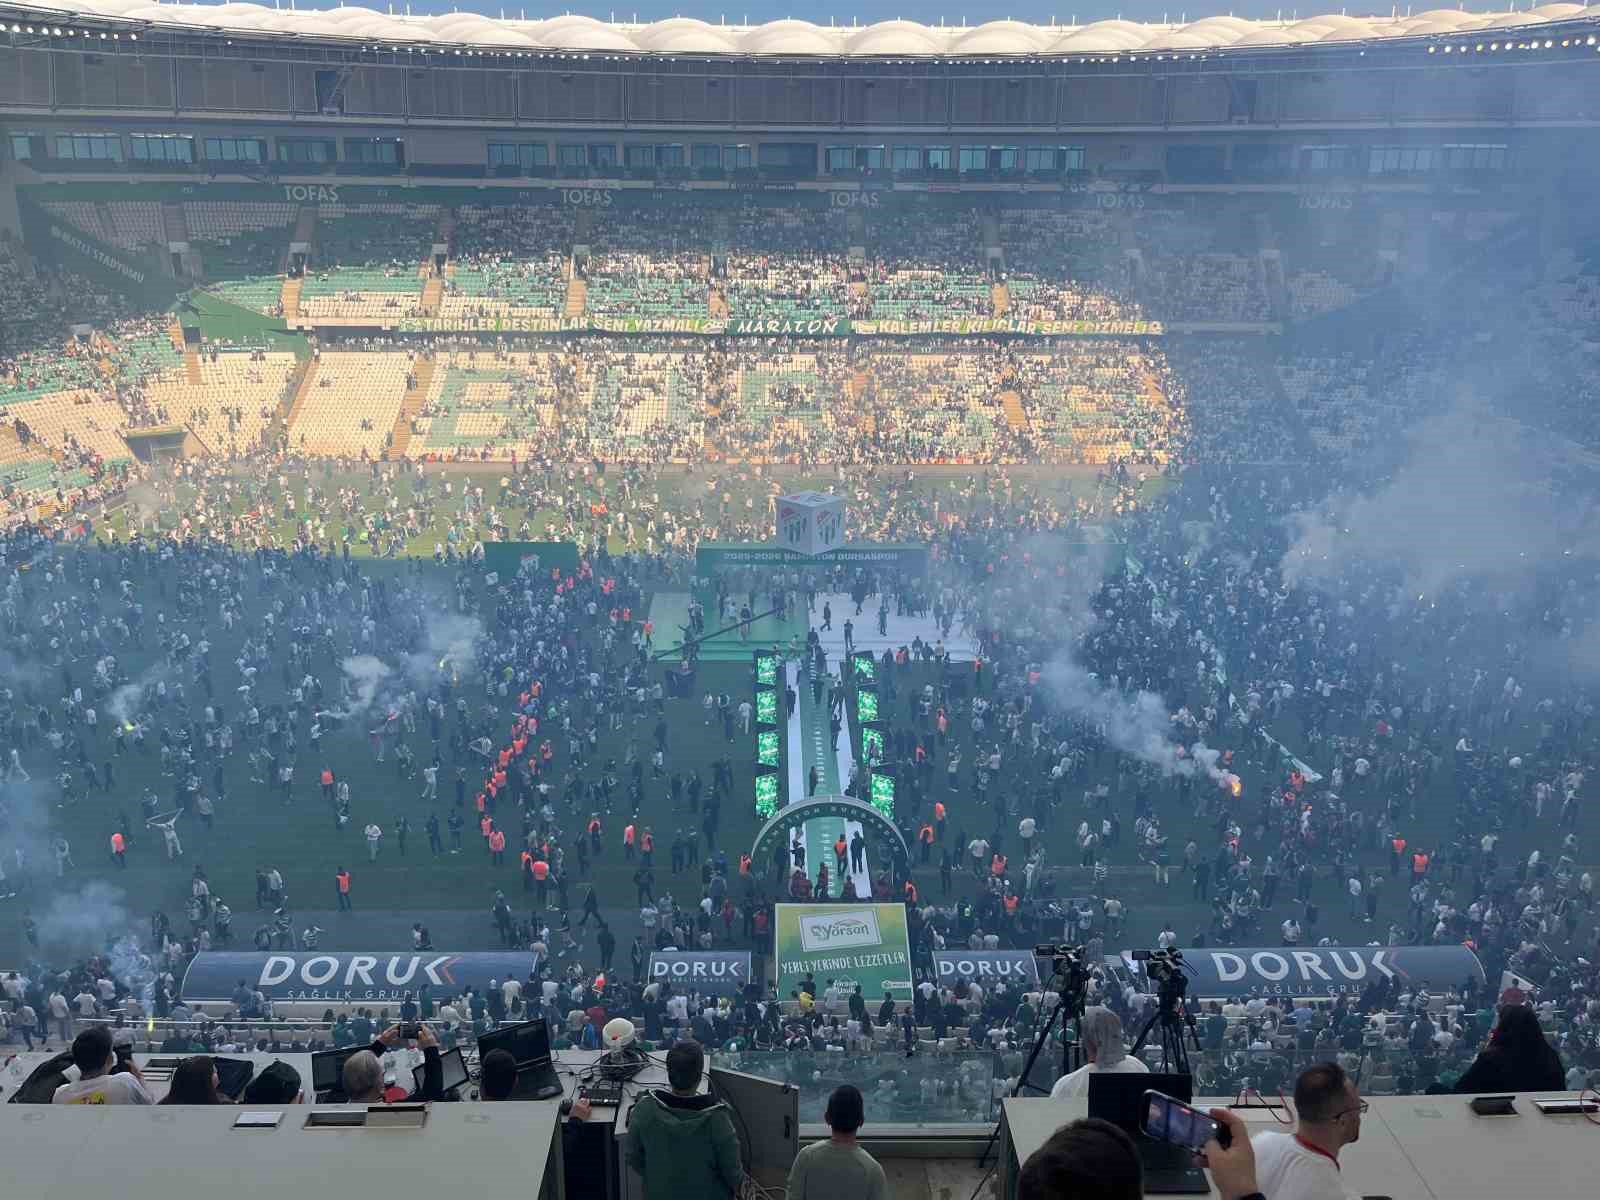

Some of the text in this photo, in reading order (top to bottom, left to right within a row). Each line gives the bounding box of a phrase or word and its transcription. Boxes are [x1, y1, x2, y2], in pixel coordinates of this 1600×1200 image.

[284, 185, 338, 203] TOFAŞ
[561, 189, 613, 207] TOFAŞ
[737, 319, 838, 335] MARATON
[822, 924, 870, 941] Yörsan
[258, 955, 464, 986] DORUK
[653, 961, 745, 977] DORUK
[811, 957, 851, 972] YERİNDE
[854, 951, 906, 969] LEZZETLER
[938, 960, 1032, 976] DORUK
[1210, 951, 1411, 983] DORUK
